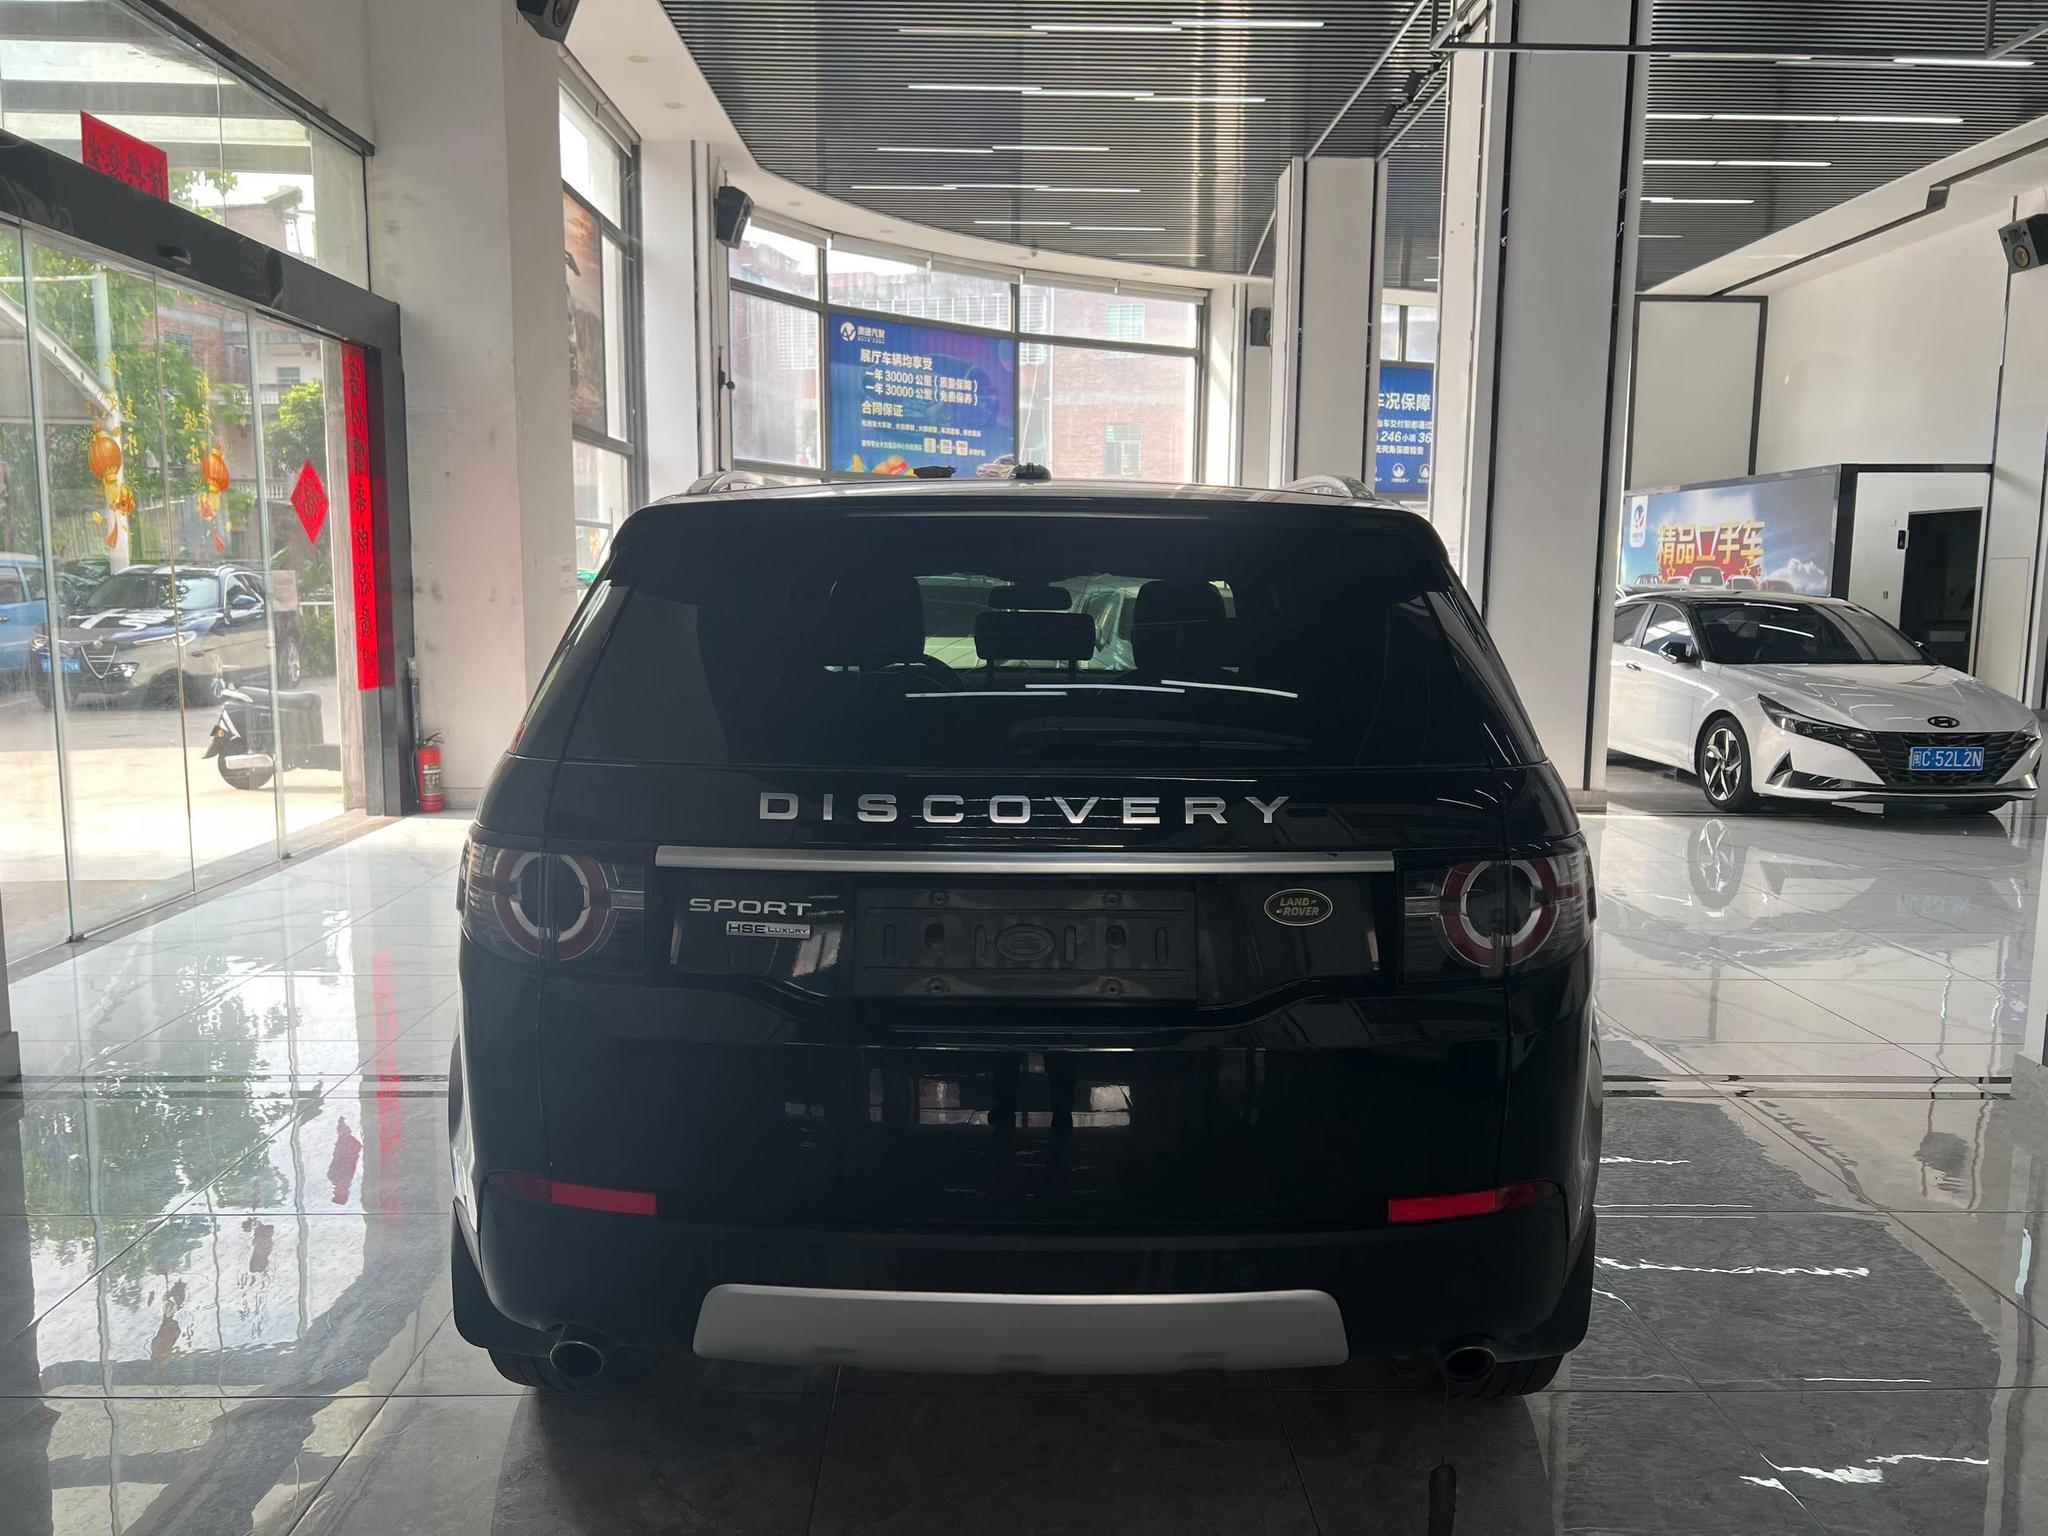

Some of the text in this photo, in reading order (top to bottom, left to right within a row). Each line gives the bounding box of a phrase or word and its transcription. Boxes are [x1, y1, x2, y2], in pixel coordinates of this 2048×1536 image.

[860, 349, 933, 371] 展厅车辆均享受
[885, 371, 914, 384] 30000
[885, 385, 914, 398] 30000
[861, 400, 904, 418] 合同保证
[758, 792, 1291, 824] DISCOVERY
[689, 898, 812, 916] SPORT
[1280, 897, 1310, 906] LAND
[1282, 906, 1320, 916] ROVER
[728, 923, 808, 934] HSE LUXURY
